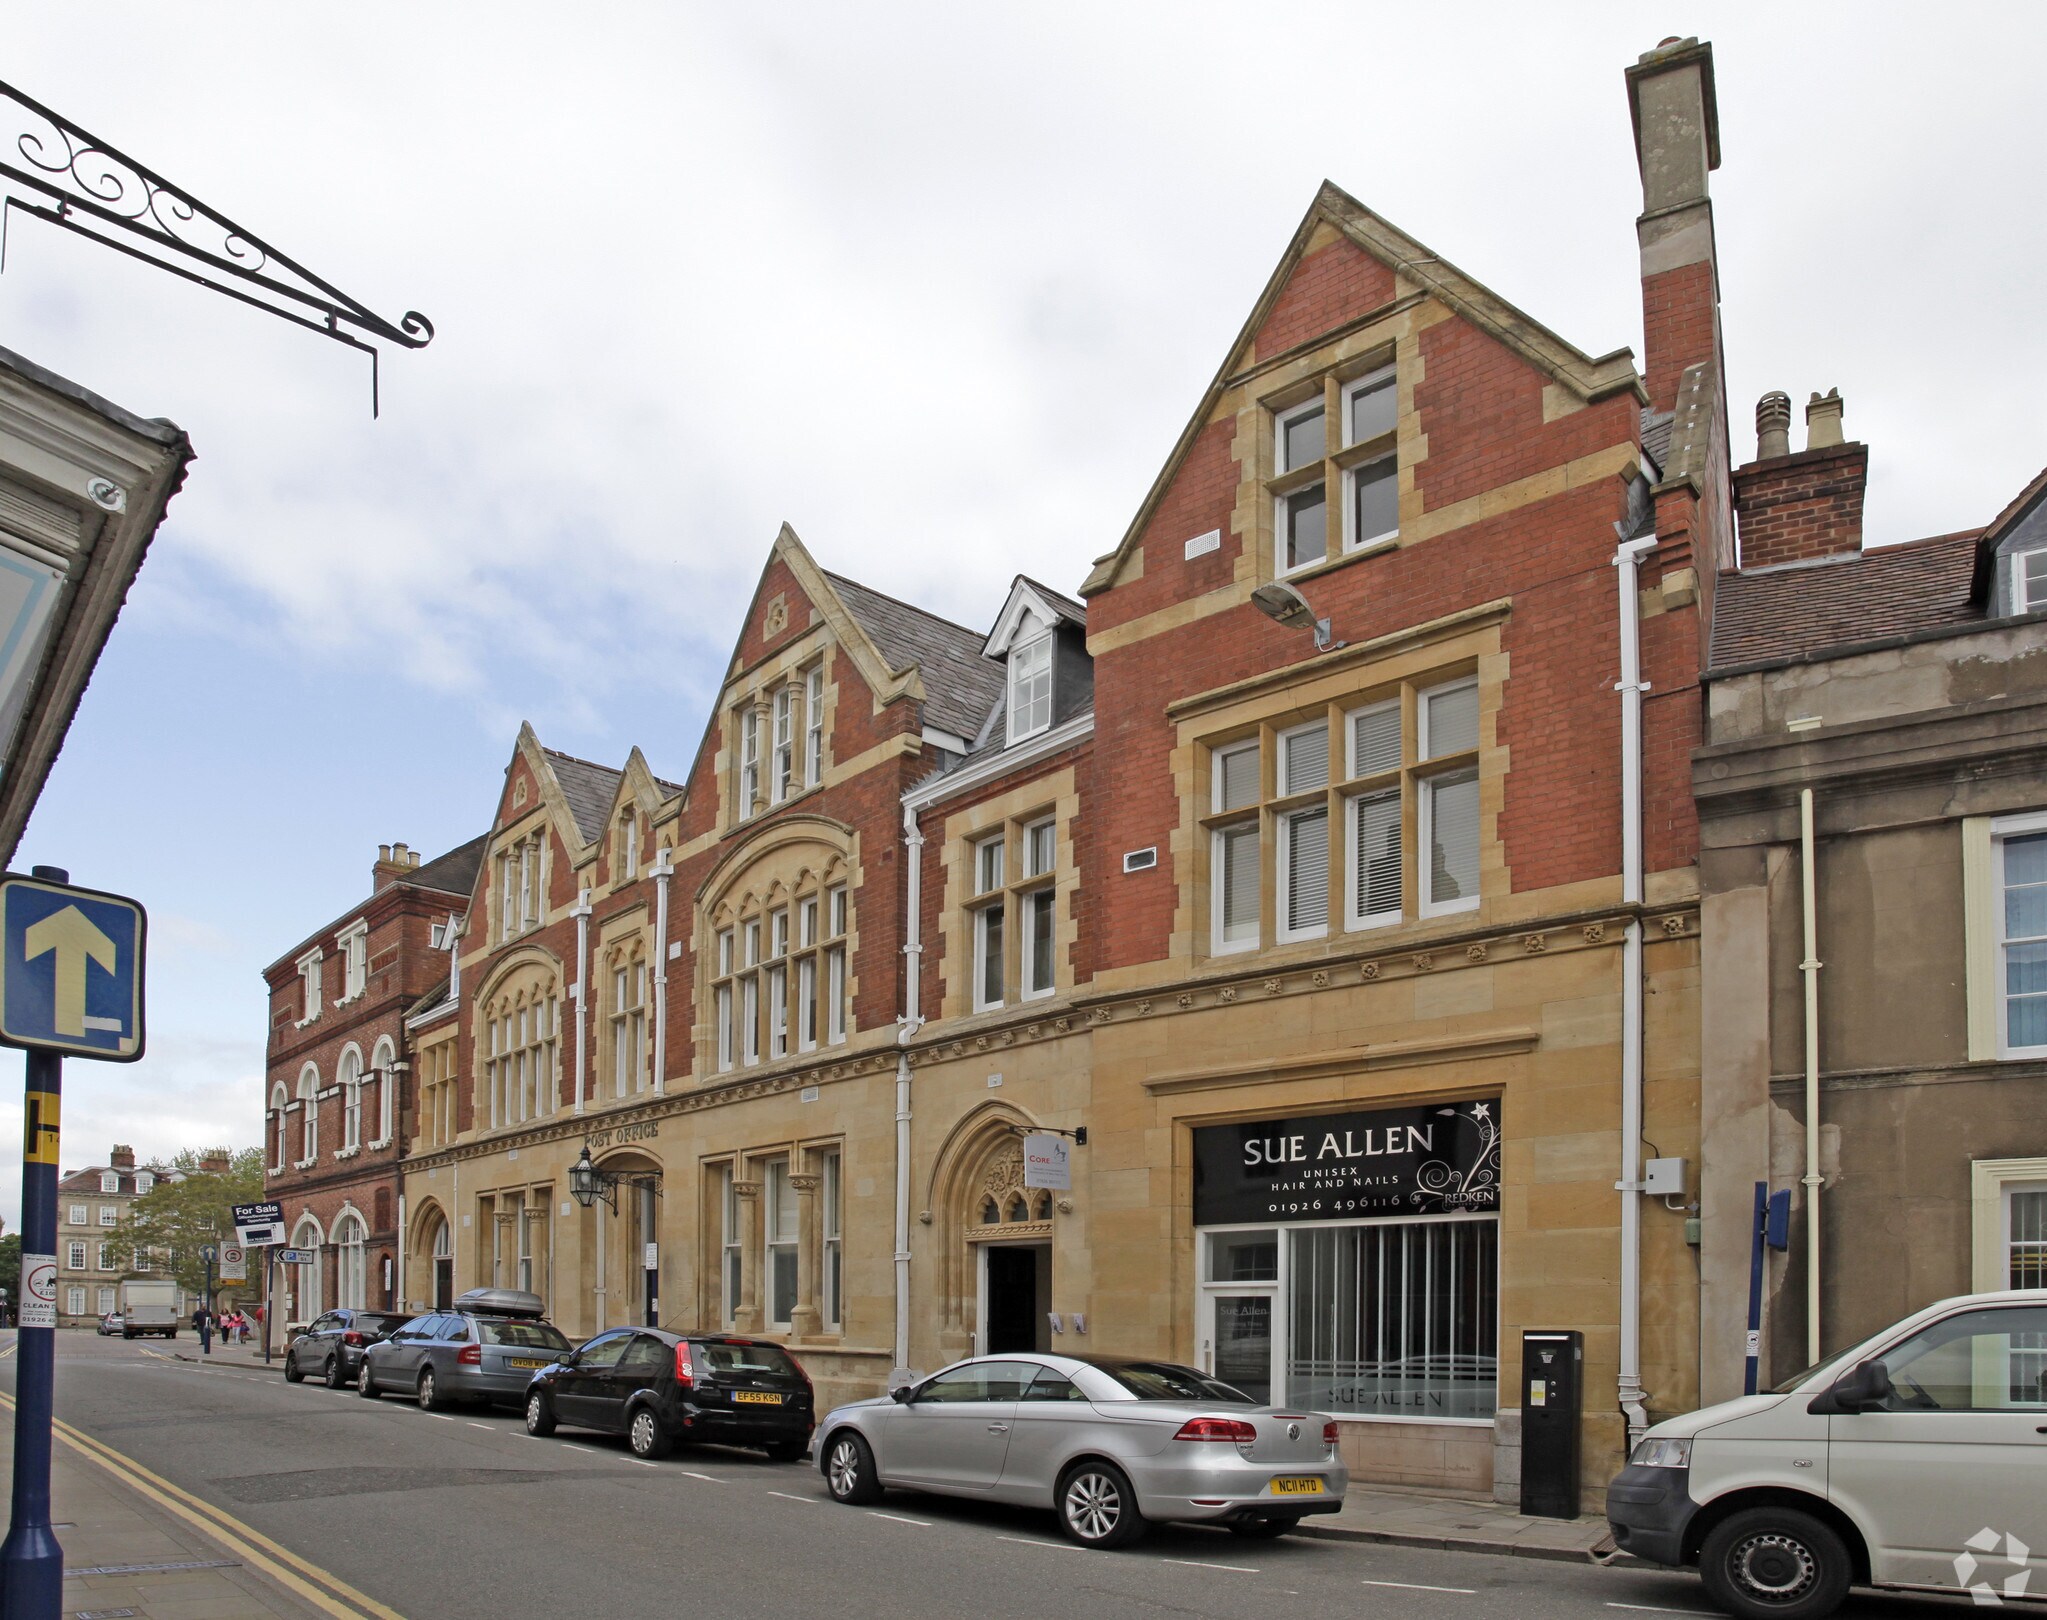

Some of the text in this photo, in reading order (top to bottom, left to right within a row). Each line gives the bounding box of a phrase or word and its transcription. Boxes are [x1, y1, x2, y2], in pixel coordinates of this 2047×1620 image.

[584, 1121, 659, 1148] POST OFFICE
[1244, 1123, 1434, 1165] SUE ALLEN
[1303, 1167, 1358, 1179] UNISEX
[1271, 1175, 1399, 1192] HAIR AND NAILS
[1445, 1191, 1494, 1203] REDKEN
[1268, 1194, 1400, 1213] 01926 496116
[236, 1205, 278, 1215] For Sale
[1220, 1306, 1267, 1315] Sue Allen
[737, 1392, 780, 1402] EF55 KSN
[1278, 1480, 1317, 1492] NC11 HTD
